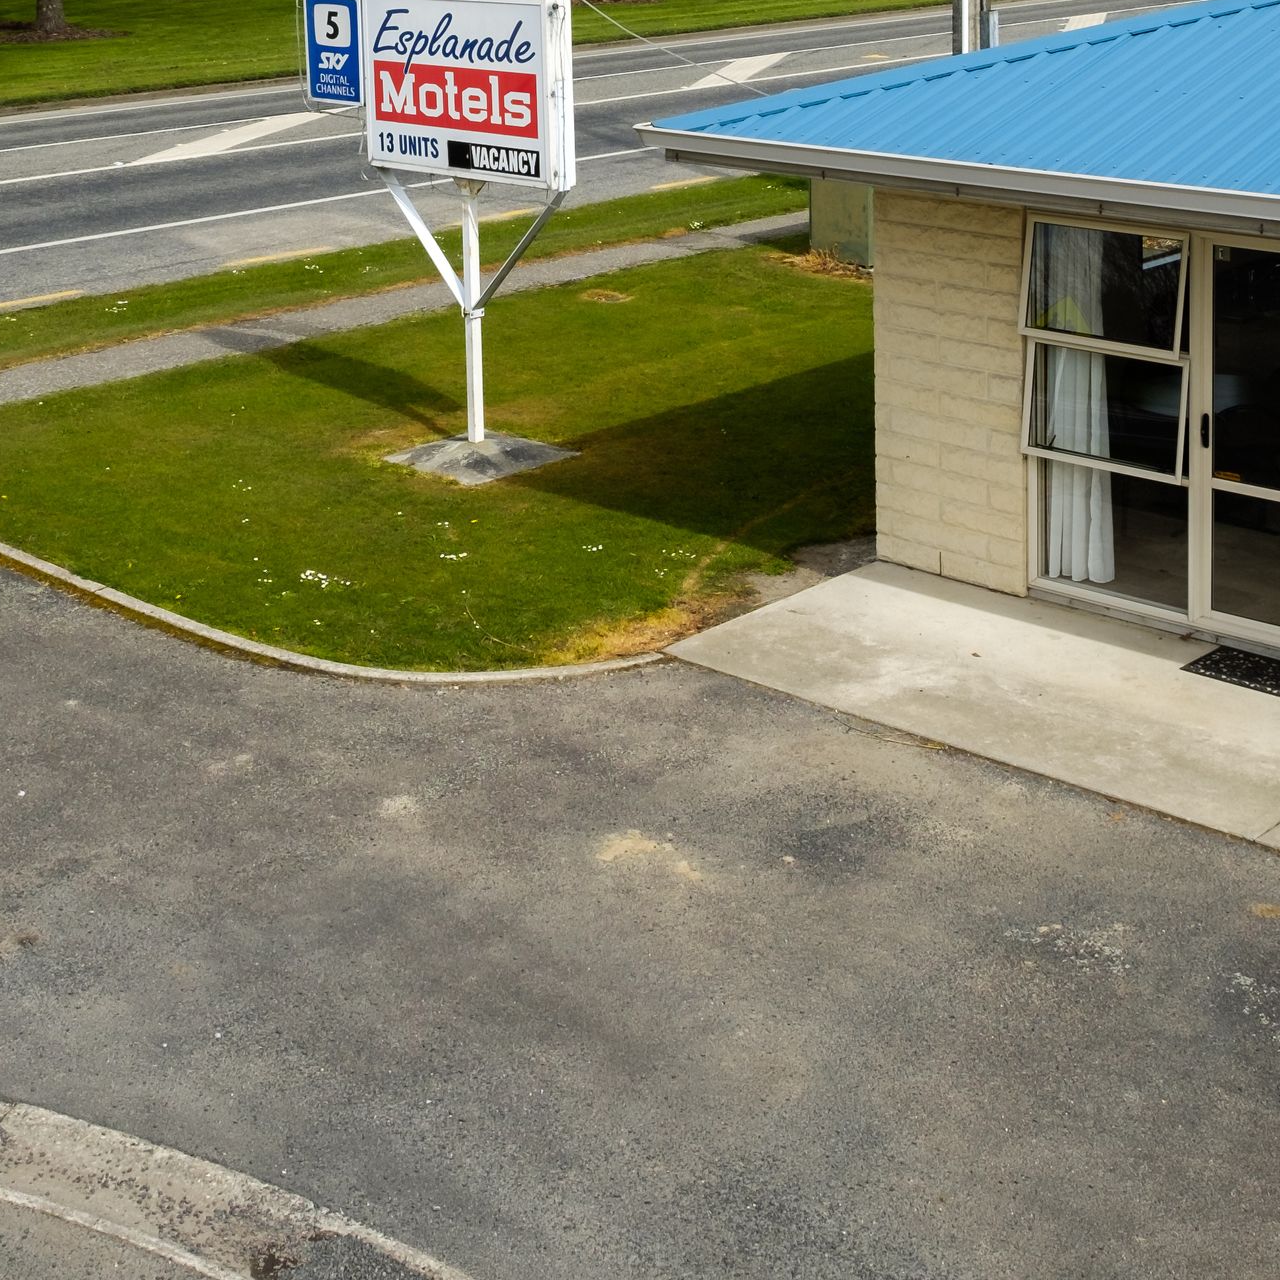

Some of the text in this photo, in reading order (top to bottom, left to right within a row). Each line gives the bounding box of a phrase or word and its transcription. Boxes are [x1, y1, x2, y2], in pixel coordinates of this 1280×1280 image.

[326, 11, 339, 40] 5
[372, 8, 536, 74] Esplanade
[318, 52, 349, 70] SKY
[316, 84, 355, 96] CHANNELS
[320, 74, 349, 85] DIGITAL
[379, 70, 531, 127] Motels
[379, 132, 439, 158] 13 UNITS
[472, 146, 538, 174] VACANCY
